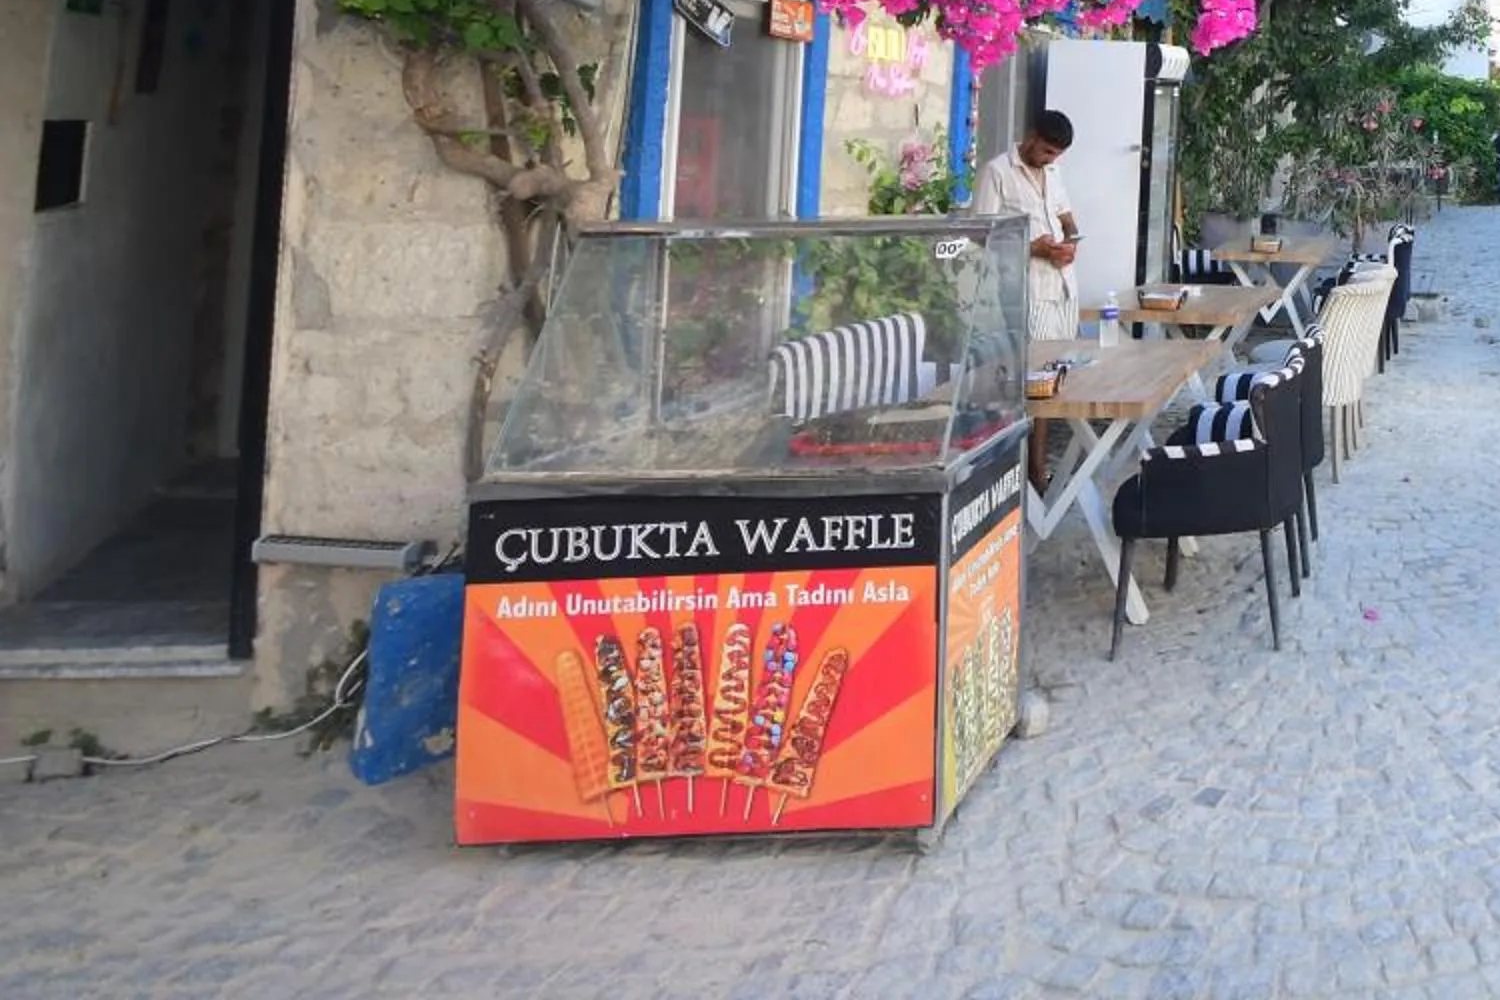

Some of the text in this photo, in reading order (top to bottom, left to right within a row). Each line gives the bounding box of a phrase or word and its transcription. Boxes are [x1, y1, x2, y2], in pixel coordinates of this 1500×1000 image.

[495, 513, 916, 572] ÇUBUKTA WAFFLE
[497, 580, 910, 619] Adını Unutabilirsin Ama Tadını Asla
